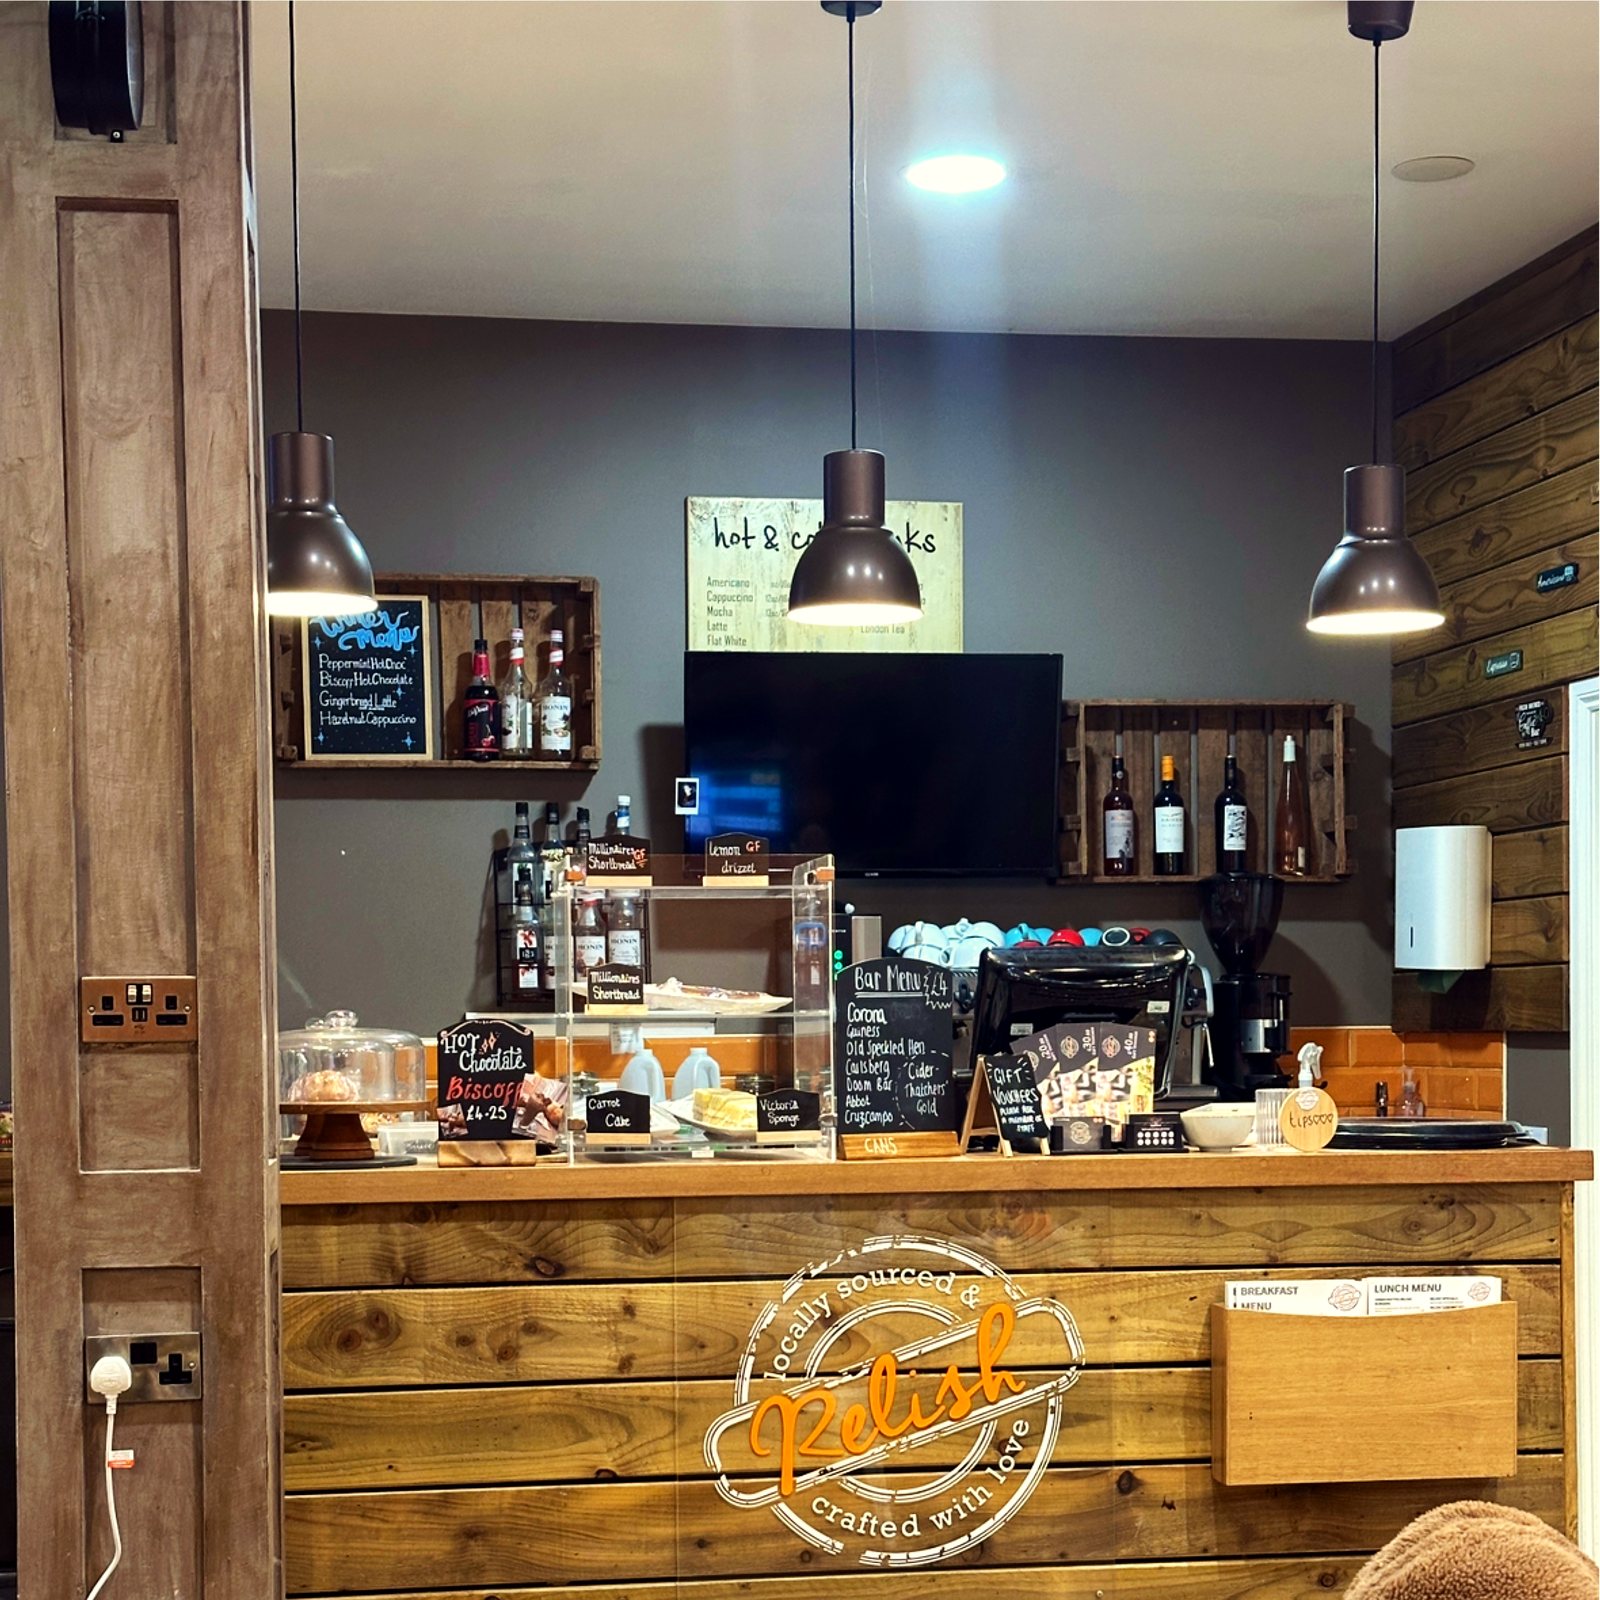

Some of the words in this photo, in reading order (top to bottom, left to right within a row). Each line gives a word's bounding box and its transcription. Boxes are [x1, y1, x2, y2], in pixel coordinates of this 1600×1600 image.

[714, 516, 757, 549] hot
[763, 525, 780, 552] &
[791, 521, 824, 550] co
[706, 576, 750, 588] Americano
[706, 590, 754, 605] Cappuccino
[706, 606, 733, 617] Mocha
[706, 620, 728, 632] Latte
[706, 634, 722, 646] Flat
[724, 634, 748, 647] White
[745, 840, 761, 852] GF
[854, 966, 882, 991] Bar
[886, 964, 921, 992] Menu
[847, 1001, 888, 1025] Corona
[846, 1039, 865, 1057] Old
[866, 1037, 906, 1060] Speckled
[907, 1038, 926, 1057] Hen
[459, 1046, 527, 1073] Chocolate
[993, 1067, 1023, 1086] GIFT
[846, 1077, 872, 1092] Doom
[876, 1077, 893, 1092] Bar
[588, 1097, 621, 1110] Carrot
[845, 1094, 871, 1108] Abbot
[916, 1096, 939, 1117] Gold
[605, 1113, 632, 1127] Cake
[844, 1109, 894, 1129] Cruzcampo
[863, 1136, 898, 1155] CANS
[1240, 1286, 1299, 1296] BREAKFAST
[1374, 1284, 1409, 1294] LUNCH
[1411, 1283, 1442, 1293] MENU
[1240, 1301, 1272, 1311] MENU
[763, 1291, 832, 1382] locally
[836, 1266, 957, 1300] sourced
[960, 1284, 981, 1309] &
[749, 1301, 1027, 1497] Relish
[811, 1495, 922, 1539] crafted
[929, 1485, 994, 1530] with
[985, 1418, 1030, 1486] love
